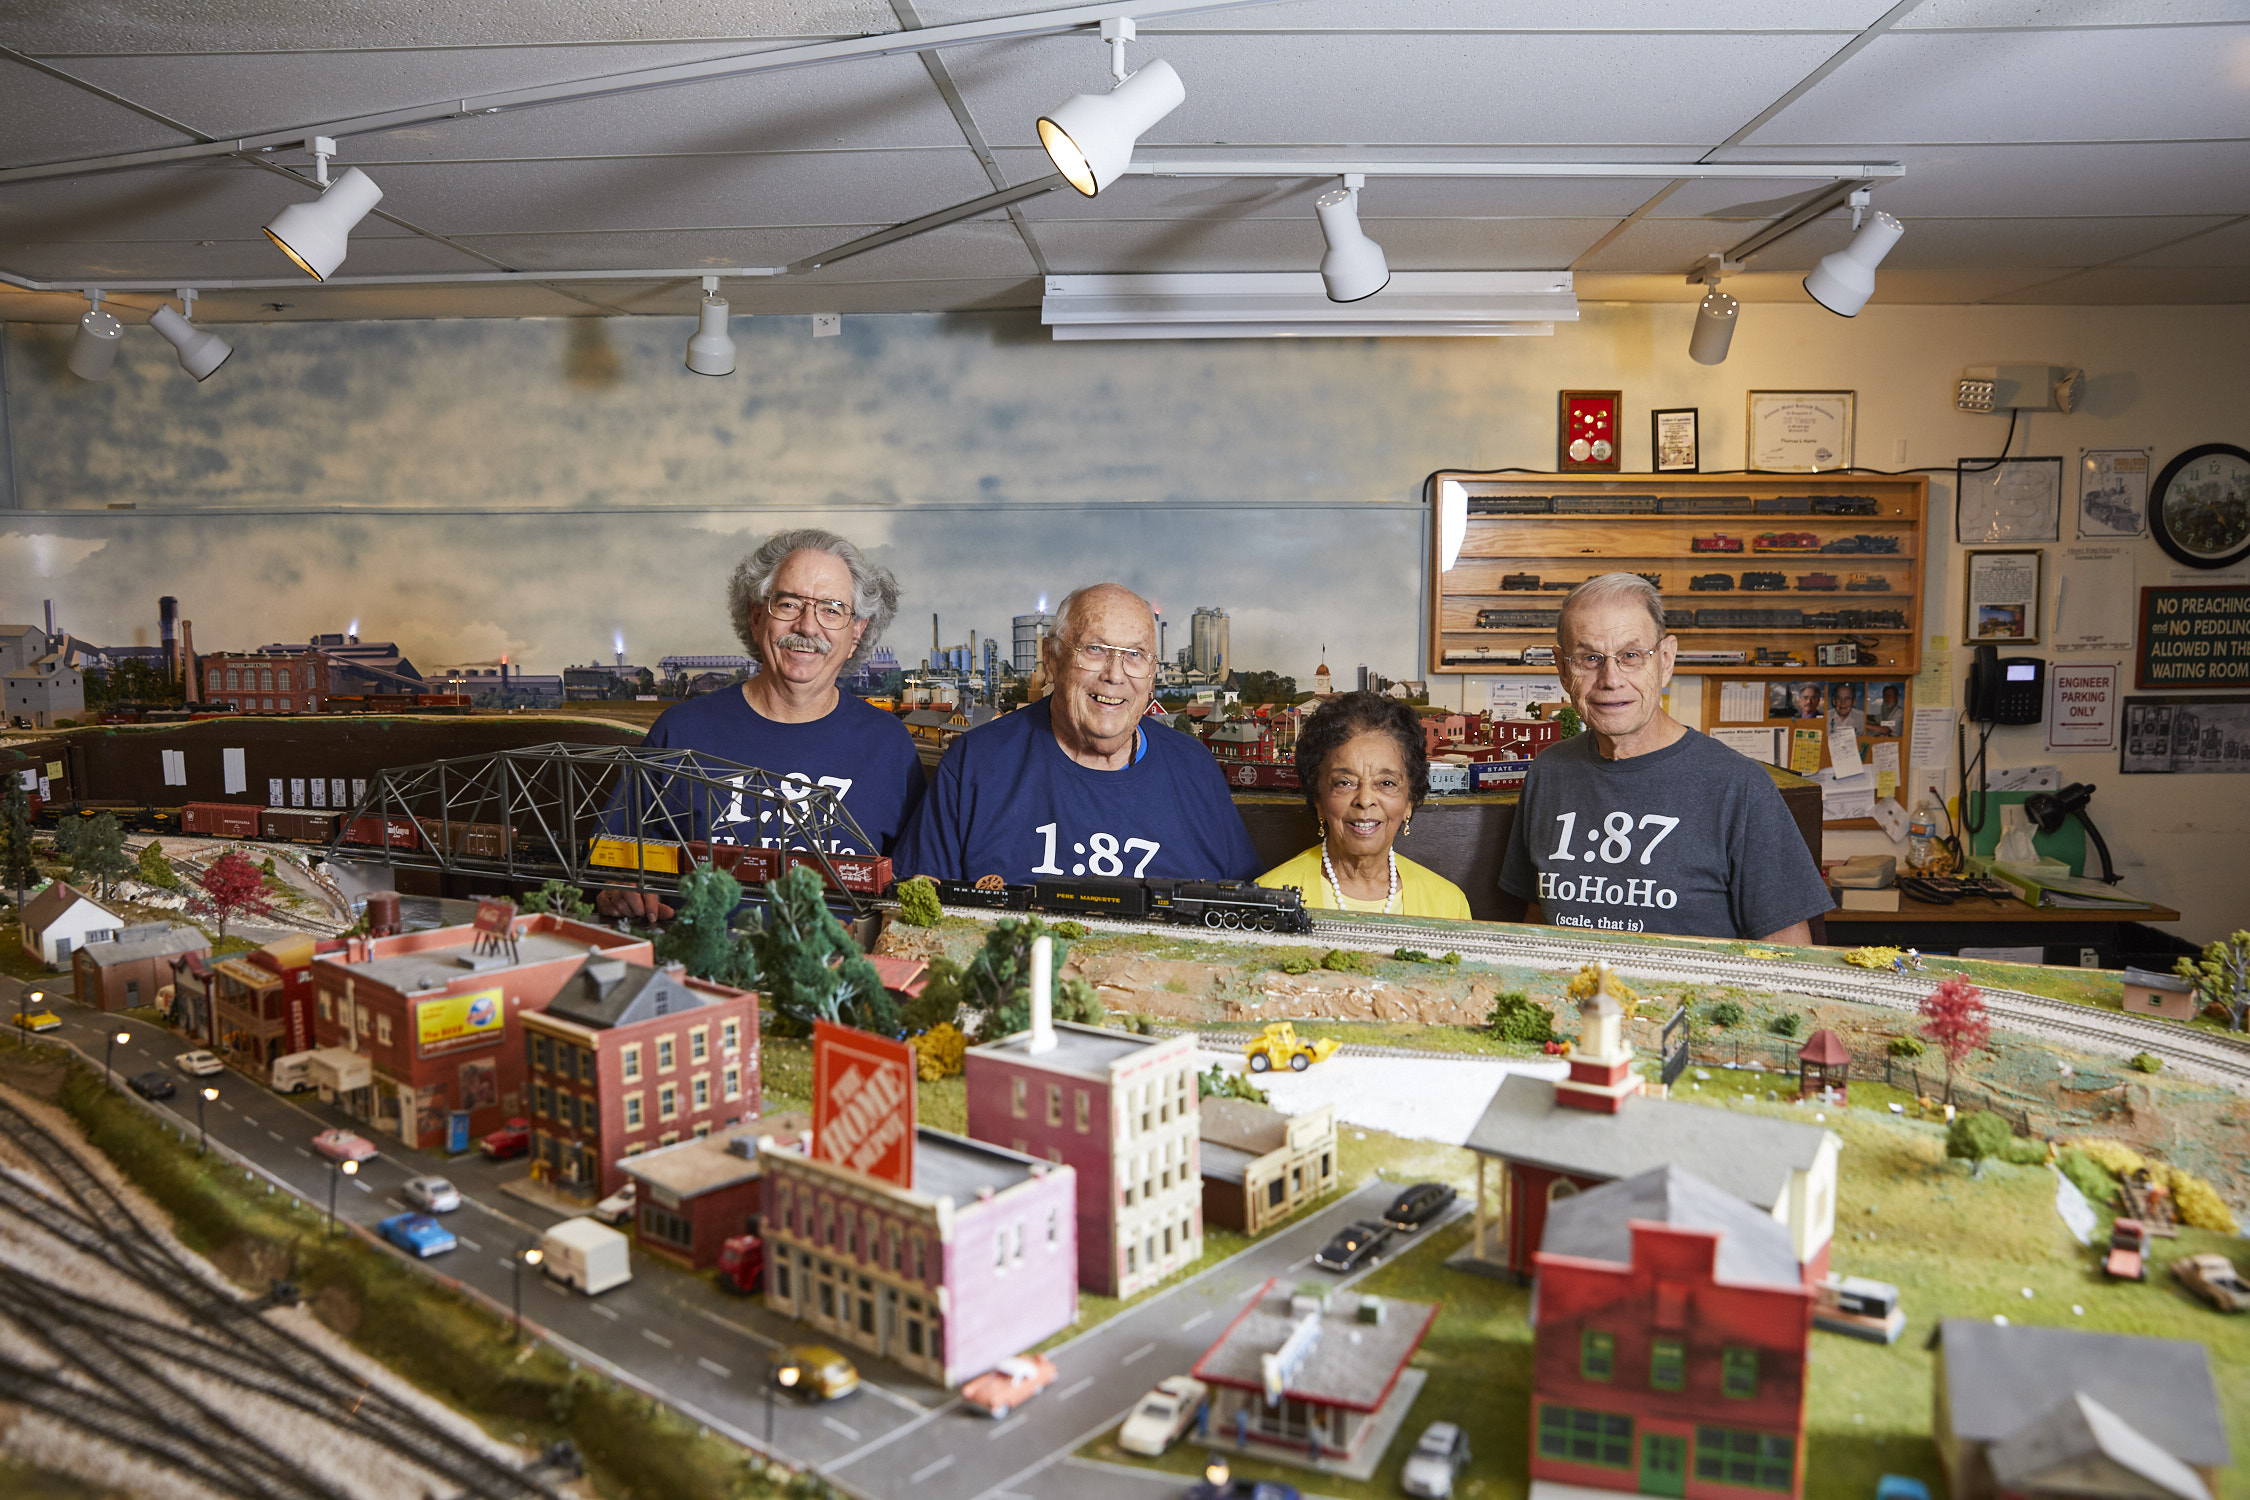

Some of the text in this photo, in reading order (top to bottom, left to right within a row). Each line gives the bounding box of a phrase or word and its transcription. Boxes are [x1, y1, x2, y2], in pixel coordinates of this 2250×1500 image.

[2157, 597, 2250, 614] NO PREACHING
[2152, 621, 2168, 632] and
[2169, 620, 2191, 636] NO
[2151, 641, 2210, 657] ALLOWED
[2213, 641, 2227, 656] IN
[2152, 662, 2249, 678] WAITING ROOM
[2059, 677, 2110, 688] ENGINEER
[2061, 691, 2105, 703] PARKING
[2069, 706, 2096, 717] ONLY
[1548, 811, 1680, 865] 1:87
[1031, 822, 1160, 879] 1:87
[1056, 892, 1121, 904] PERE MARQUETTE
[1537, 872, 1678, 909] HoHoHo
[1555, 912, 1644, 933] (scale, that is)
[821, 1059, 907, 1166] HOME
